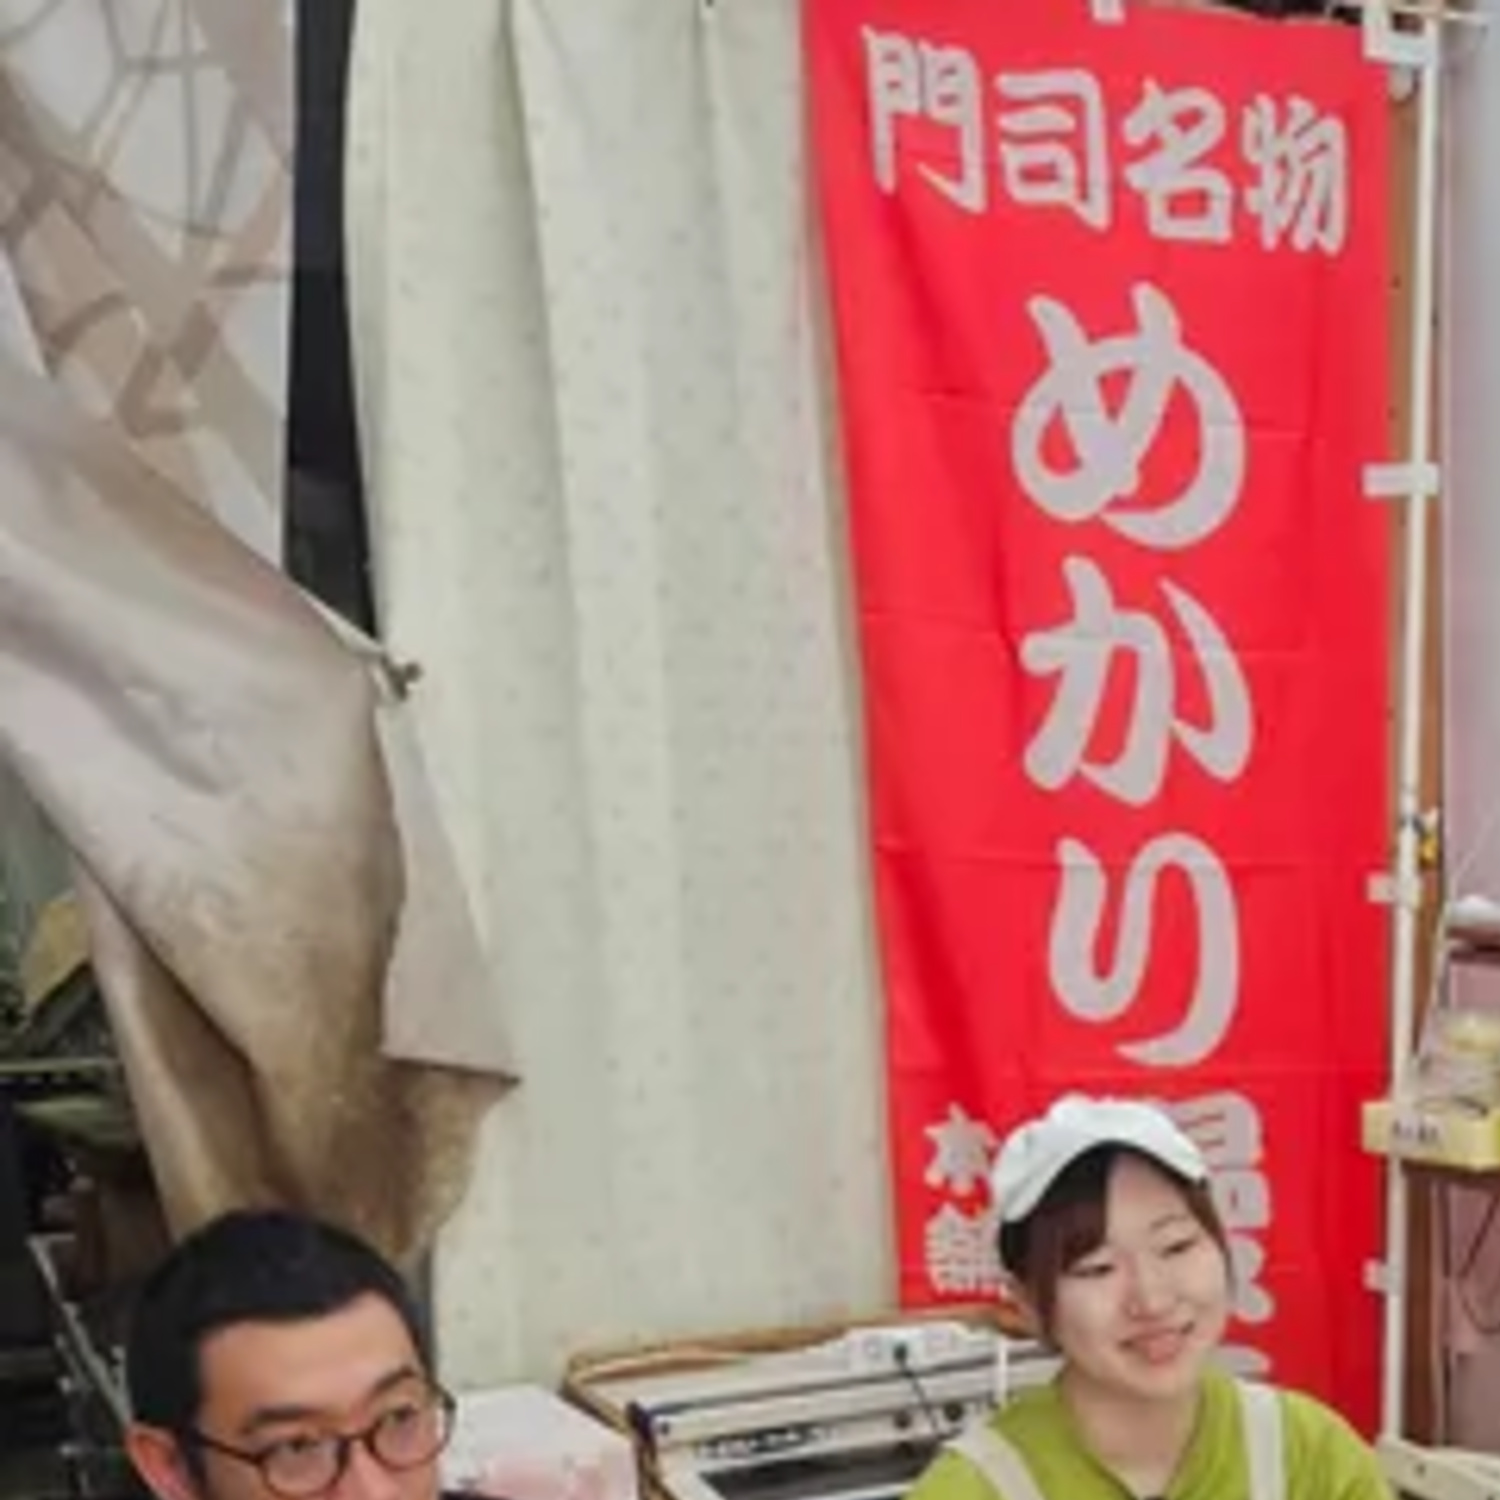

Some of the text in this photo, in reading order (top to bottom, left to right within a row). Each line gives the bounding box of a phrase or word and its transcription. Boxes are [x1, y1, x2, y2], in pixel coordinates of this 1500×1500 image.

[862, 26, 1349, 256] 門司名物
[1010, 281, 1276, 1375] めかり
